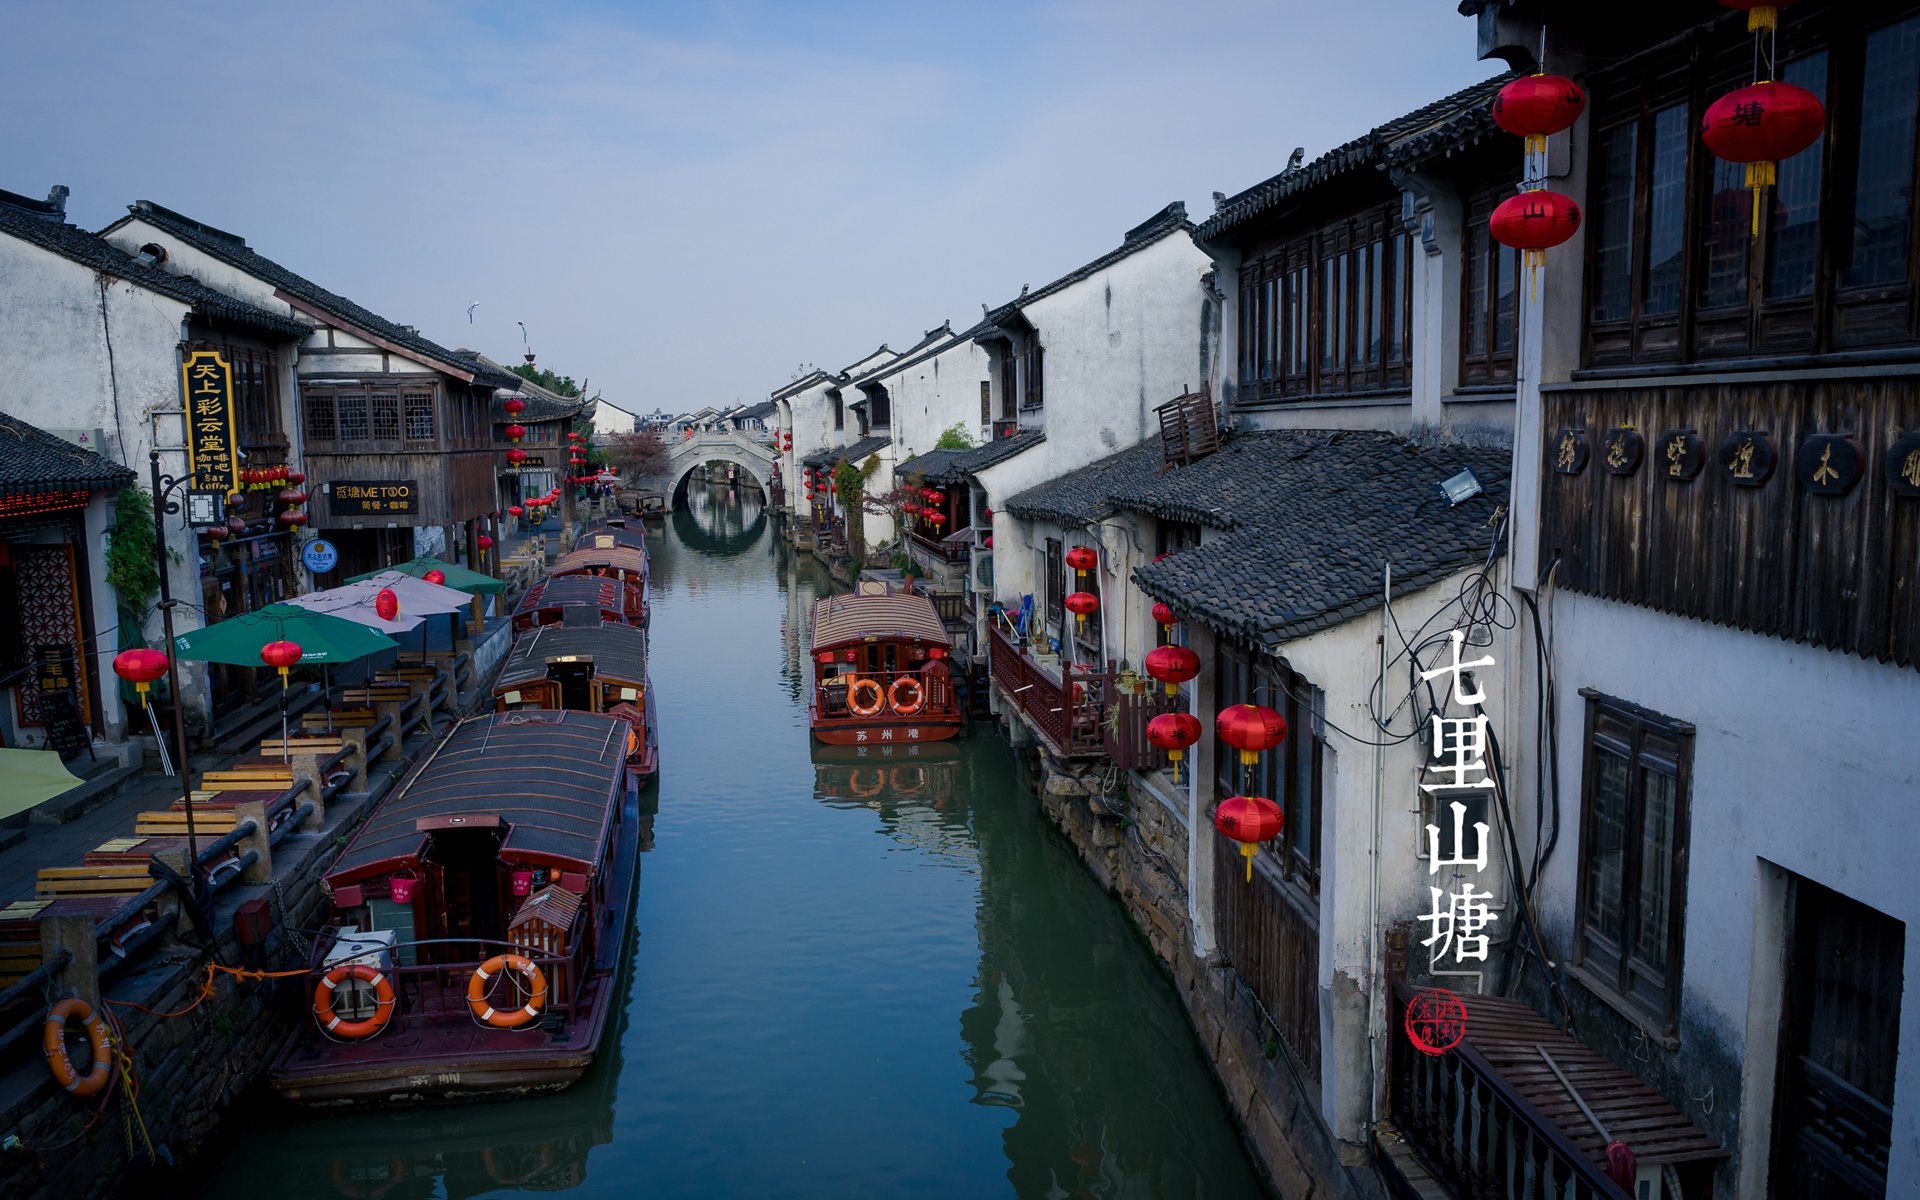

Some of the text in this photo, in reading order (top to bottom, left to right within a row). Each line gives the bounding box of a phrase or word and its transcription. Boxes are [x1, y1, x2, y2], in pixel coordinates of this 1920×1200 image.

[1731, 100, 1766, 126] 塘
[193, 364, 225, 452] 天上彩云堂
[195, 453, 230, 462] 咖啡
[1169, 660, 1184, 672] 山
[856, 728, 919, 742] 苏州港
